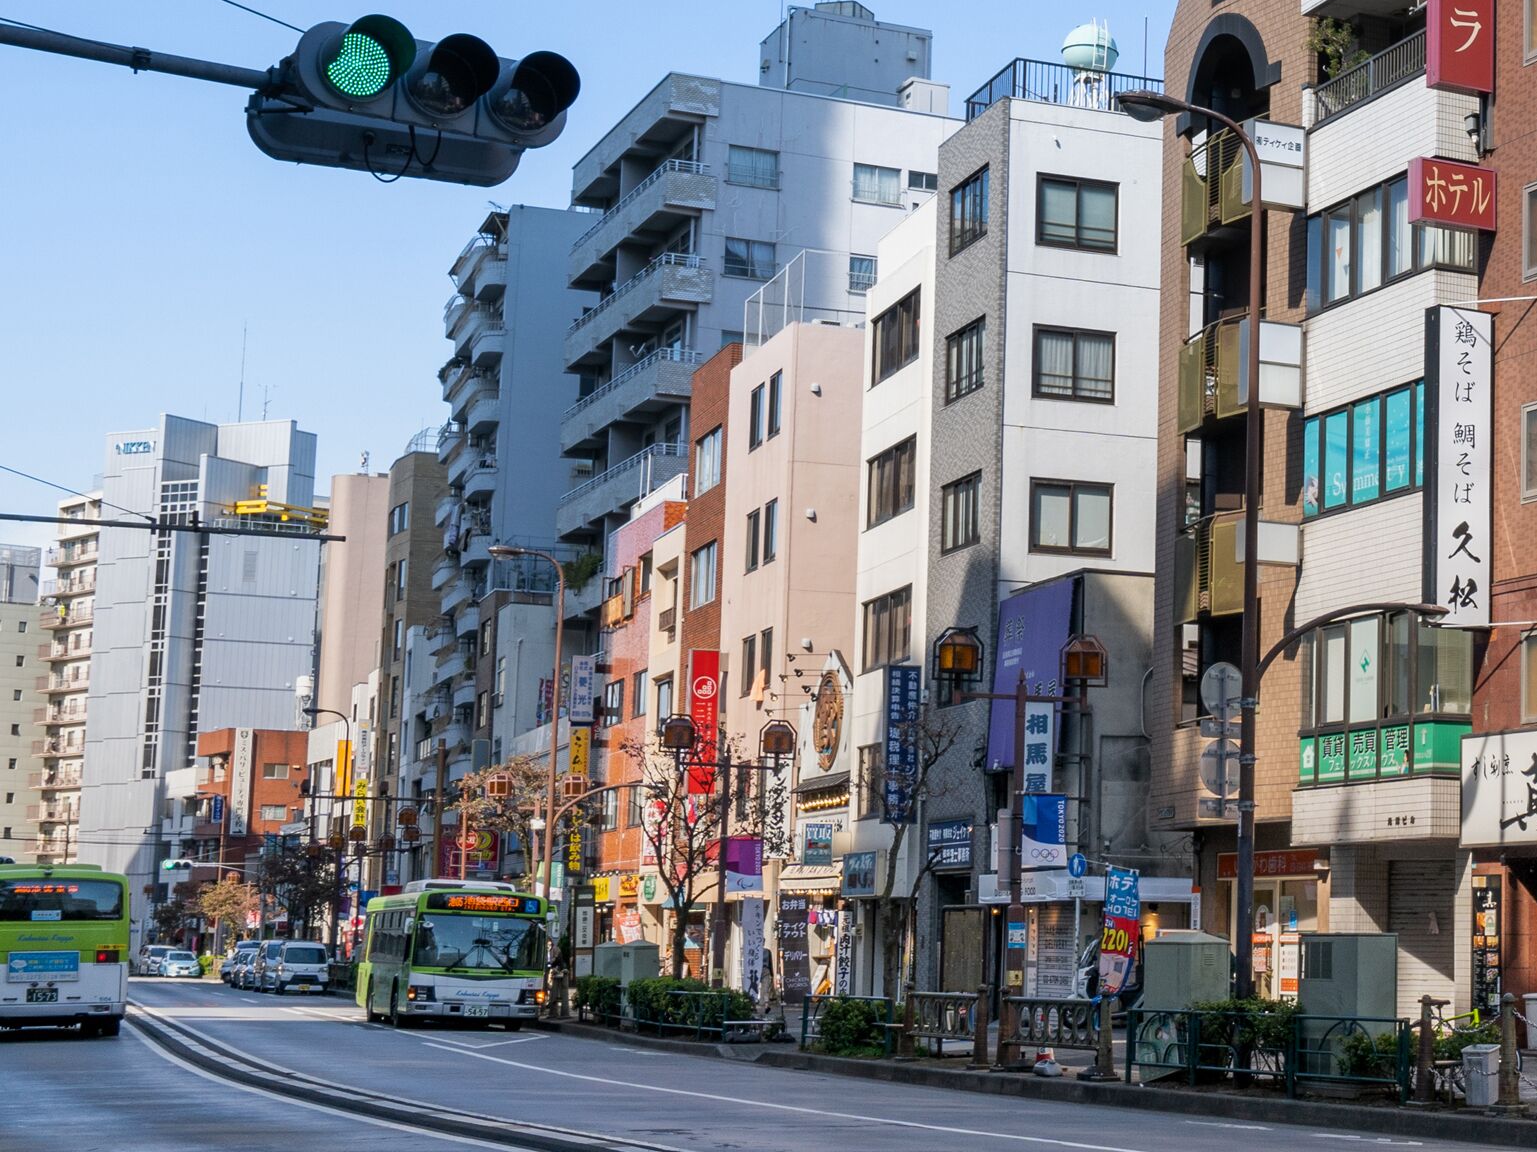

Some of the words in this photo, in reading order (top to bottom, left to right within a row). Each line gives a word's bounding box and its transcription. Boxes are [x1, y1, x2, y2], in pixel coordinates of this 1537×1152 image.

[1425, 165, 1491, 217] ホテル
[1454, 321, 1476, 404] 鶏そば
[1453, 422, 1475, 503] 鯛そば
[1448, 520, 1481, 612] 久松
[1026, 714, 1048, 793] 相馬屋
[1322, 736, 1344, 759] 賃貸
[1353, 729, 1375, 755] 売買
[1385, 727, 1408, 751] 管理
[782, 899, 806, 909] お弁当
[1109, 875, 1139, 893] ホテ
[783, 923, 805, 931] テイク
[784, 952, 808, 961] デリバリー
